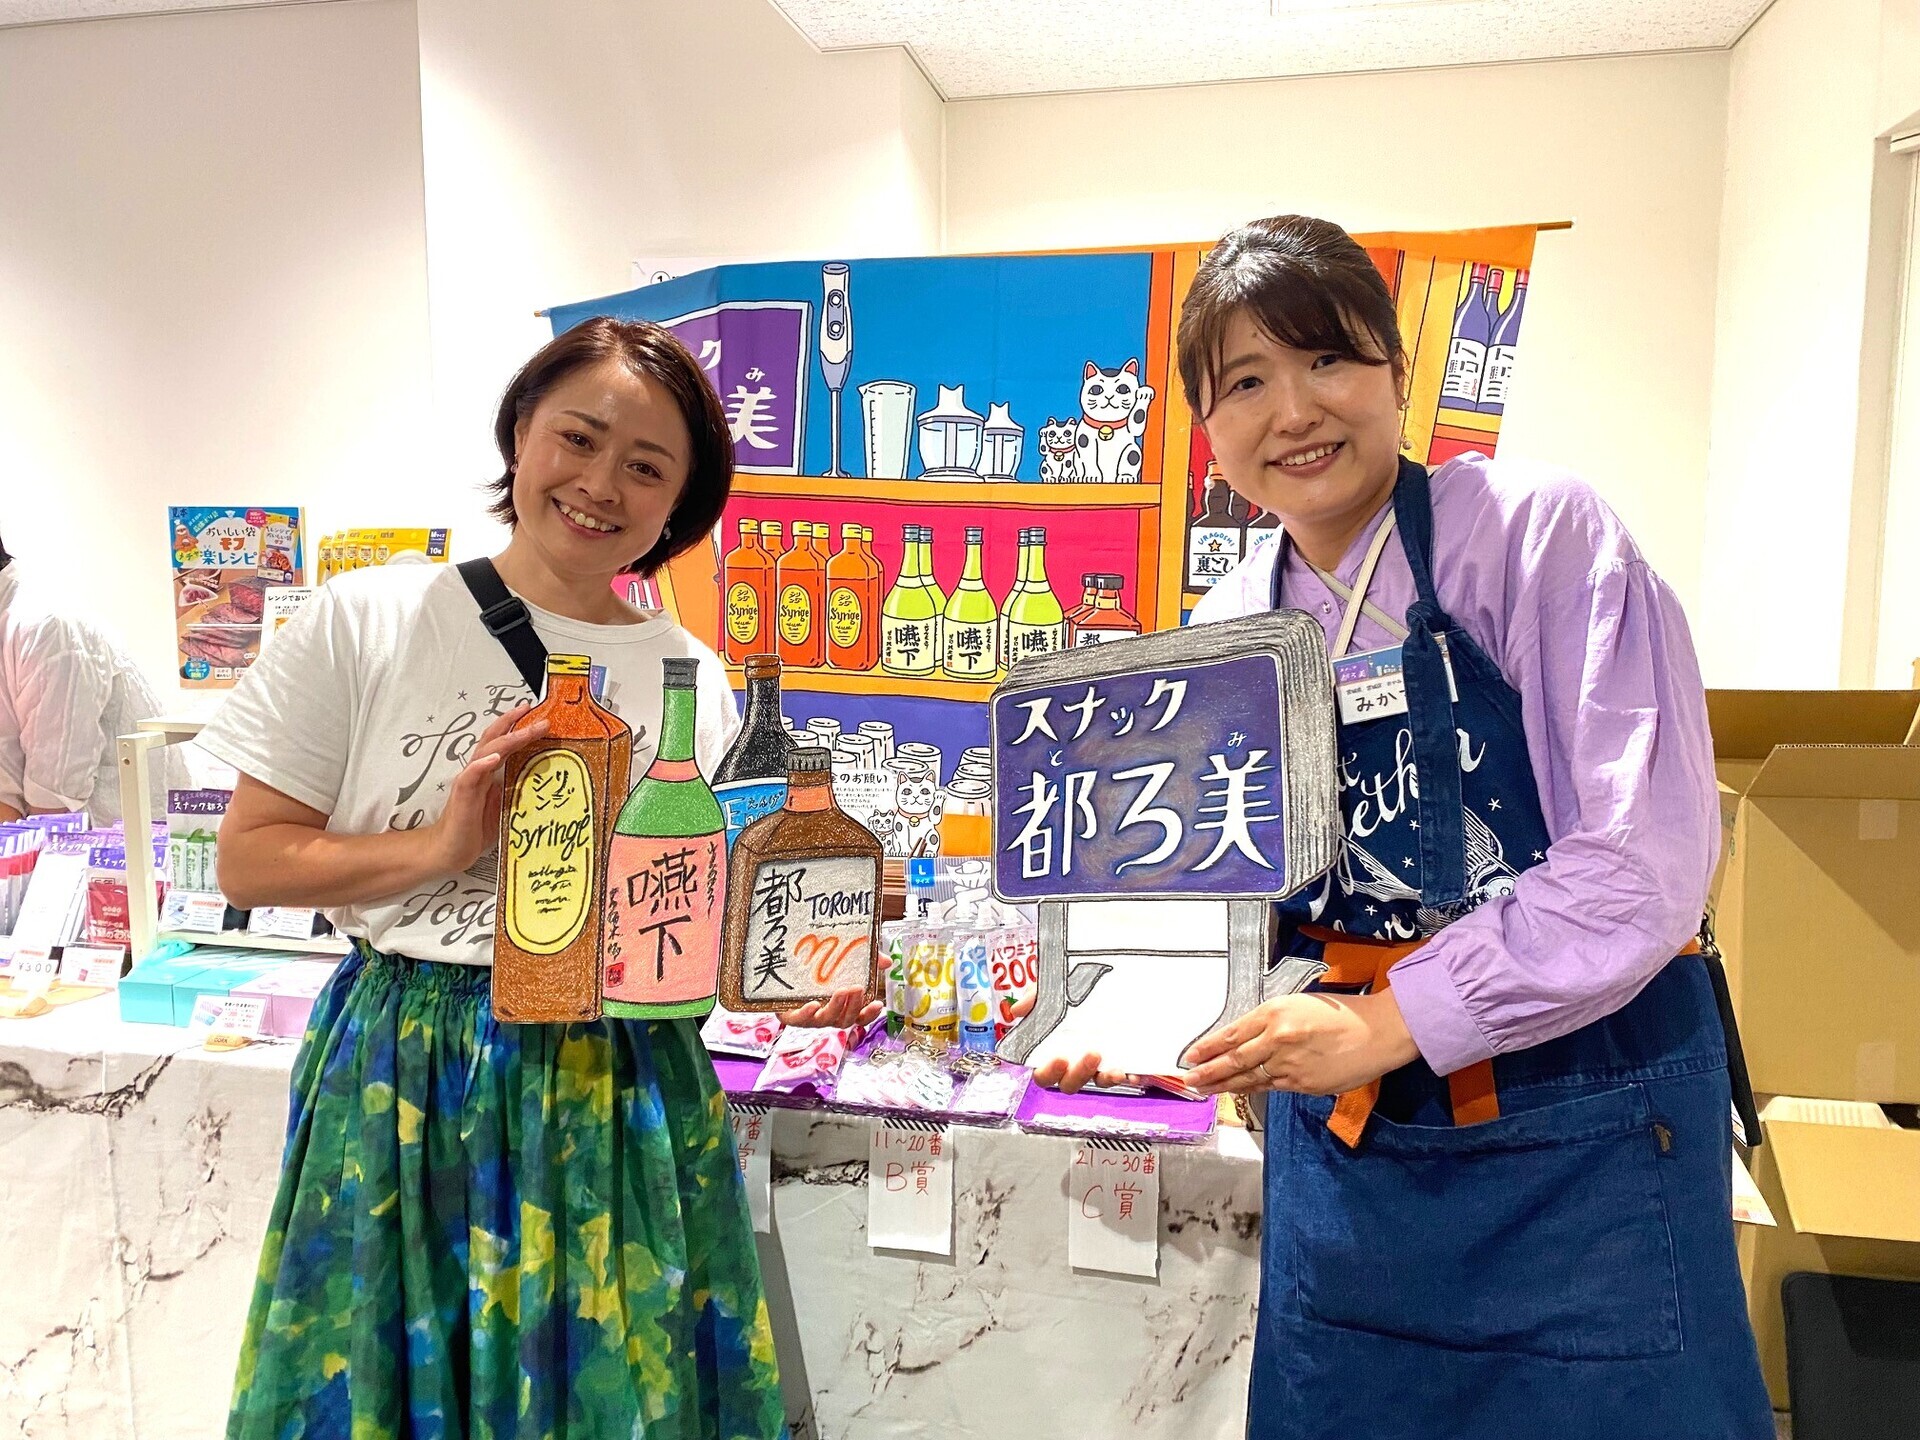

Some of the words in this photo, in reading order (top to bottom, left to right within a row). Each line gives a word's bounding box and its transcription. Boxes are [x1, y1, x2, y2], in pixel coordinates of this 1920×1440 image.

[745, 367, 766, 382] み
[1197, 532, 1235, 547] URAGOSHI
[895, 624, 921, 667] 嚥下
[957, 627, 983, 670] 嚥下
[1011, 678, 1188, 745] スナック
[1050, 750, 1064, 767] と
[1227, 731, 1247, 748] み
[1006, 750, 1280, 879] 都ろ美
[510, 814, 591, 861] Syringe
[918, 864, 926, 876] L
[627, 847, 698, 982] 嚥下
[804, 890, 872, 920] TOROMI
[751, 868, 807, 993] 都ろ美
